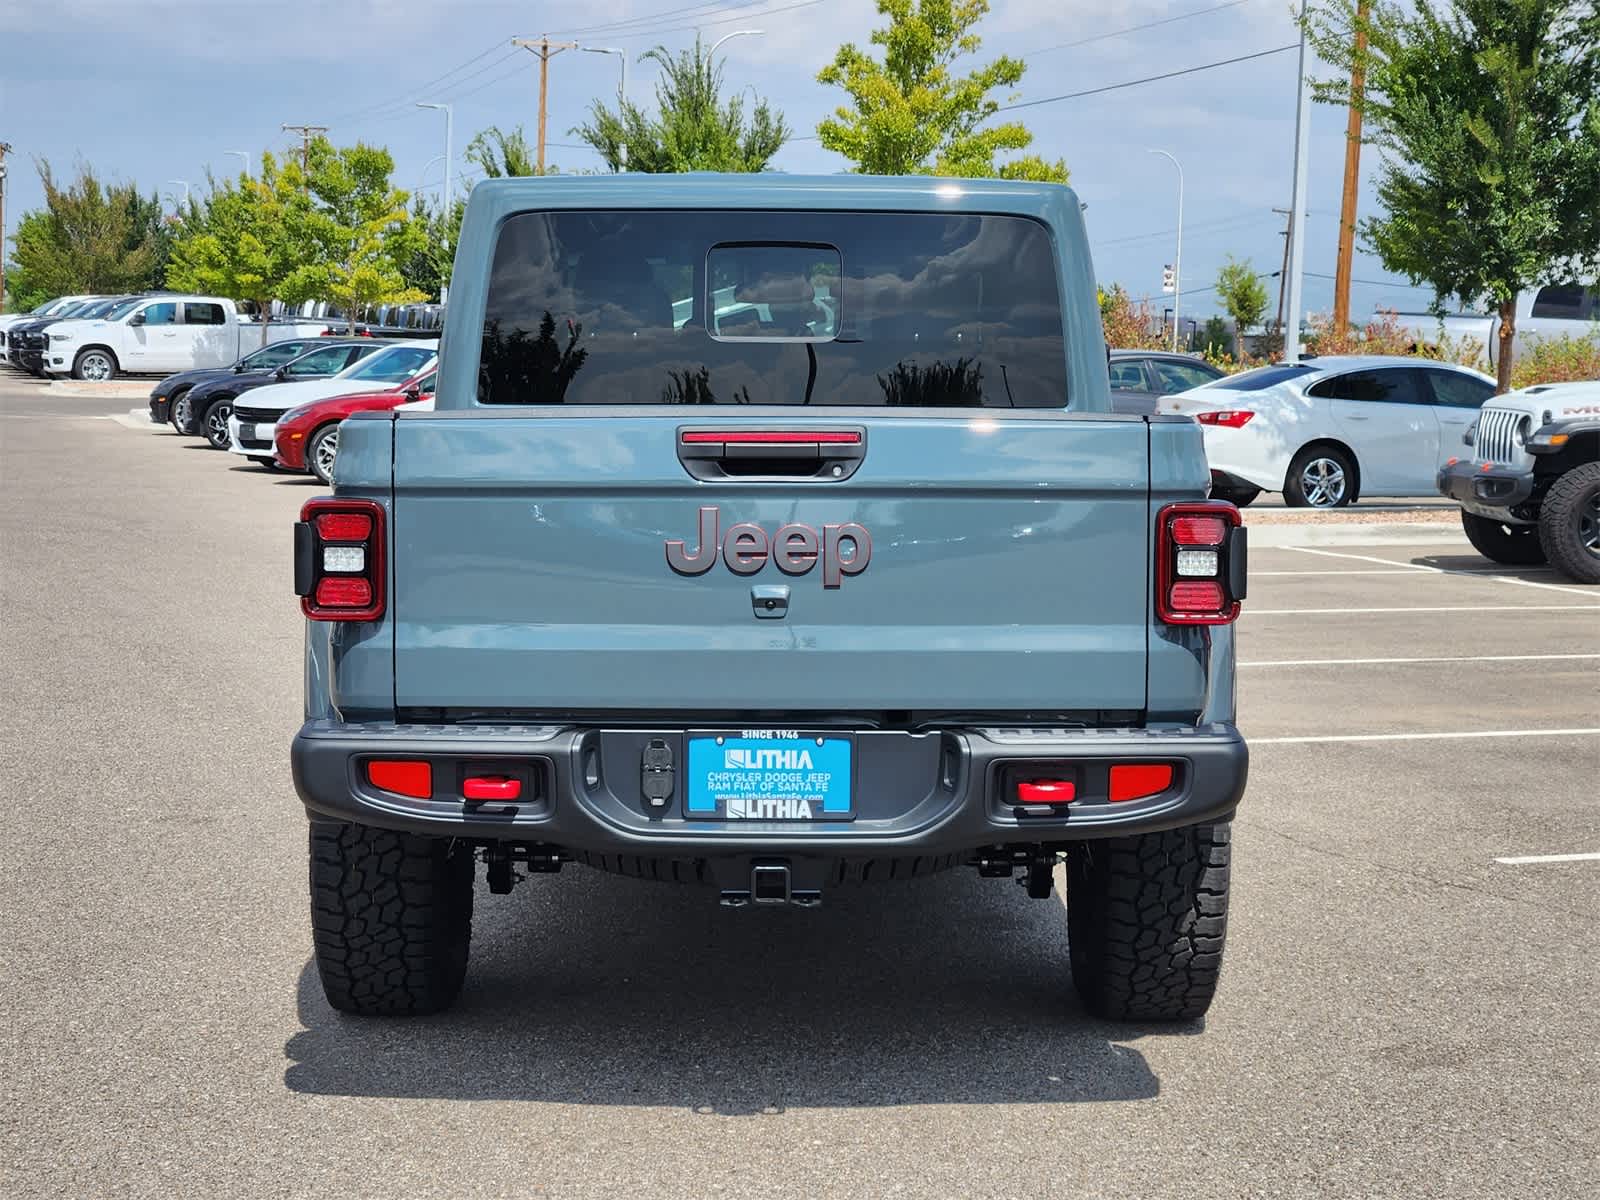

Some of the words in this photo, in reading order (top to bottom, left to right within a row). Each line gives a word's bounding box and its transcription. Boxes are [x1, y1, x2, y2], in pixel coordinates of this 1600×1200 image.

[665, 506, 872, 589] Jeep
[741, 730, 772, 739] SINCE
[776, 730, 799, 739] 1946
[745, 750, 813, 769] LITHIA
[708, 772, 761, 782] CHRYSLER
[765, 773, 801, 782] DODGE
[806, 773, 831, 783] JEEP
[708, 782, 730, 791] RAM
[734, 783, 756, 791] FIAT
[760, 783, 774, 791] OF
[778, 783, 812, 792] SANTA
[816, 783, 828, 792] FE
[746, 800, 812, 818] LITHIA
